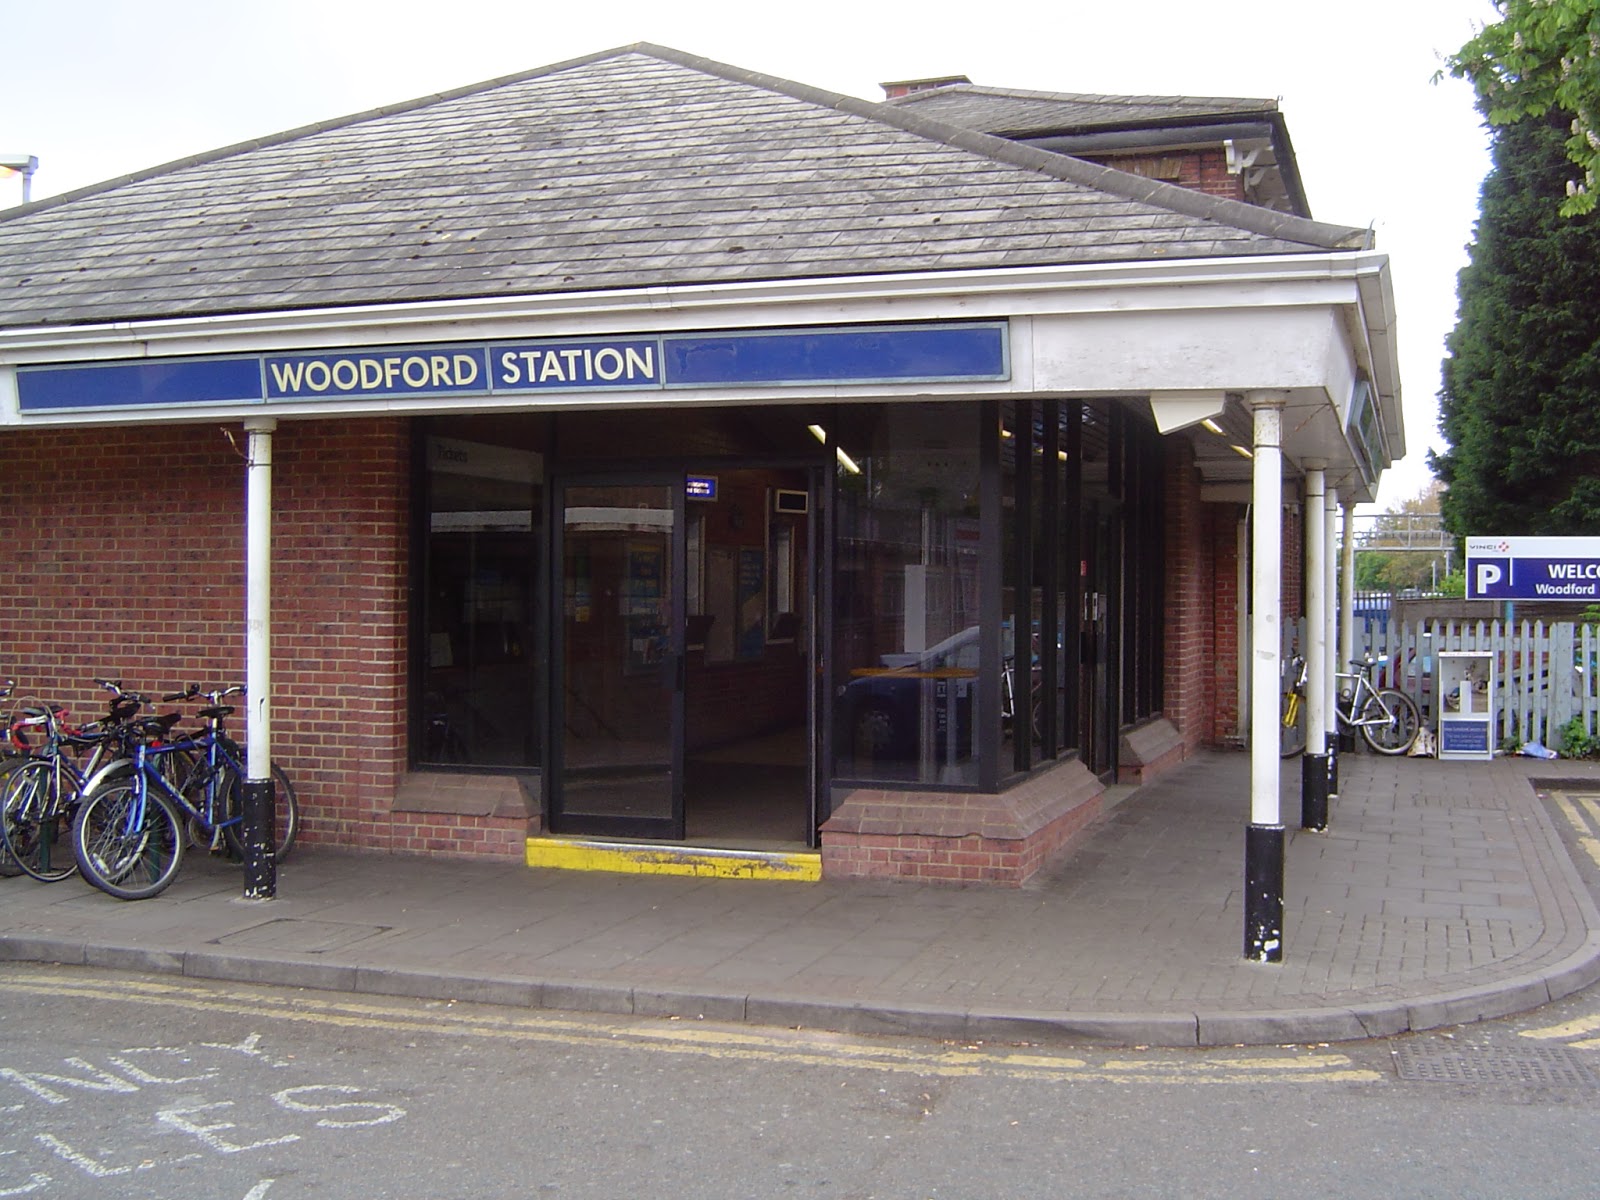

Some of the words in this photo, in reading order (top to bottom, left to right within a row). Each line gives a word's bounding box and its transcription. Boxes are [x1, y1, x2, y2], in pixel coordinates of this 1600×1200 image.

[270, 355, 478, 393] WOODFORD
[502, 346, 654, 384] STATION
[1477, 564, 1501, 594] P
[1535, 583, 1595, 594] Woodford
